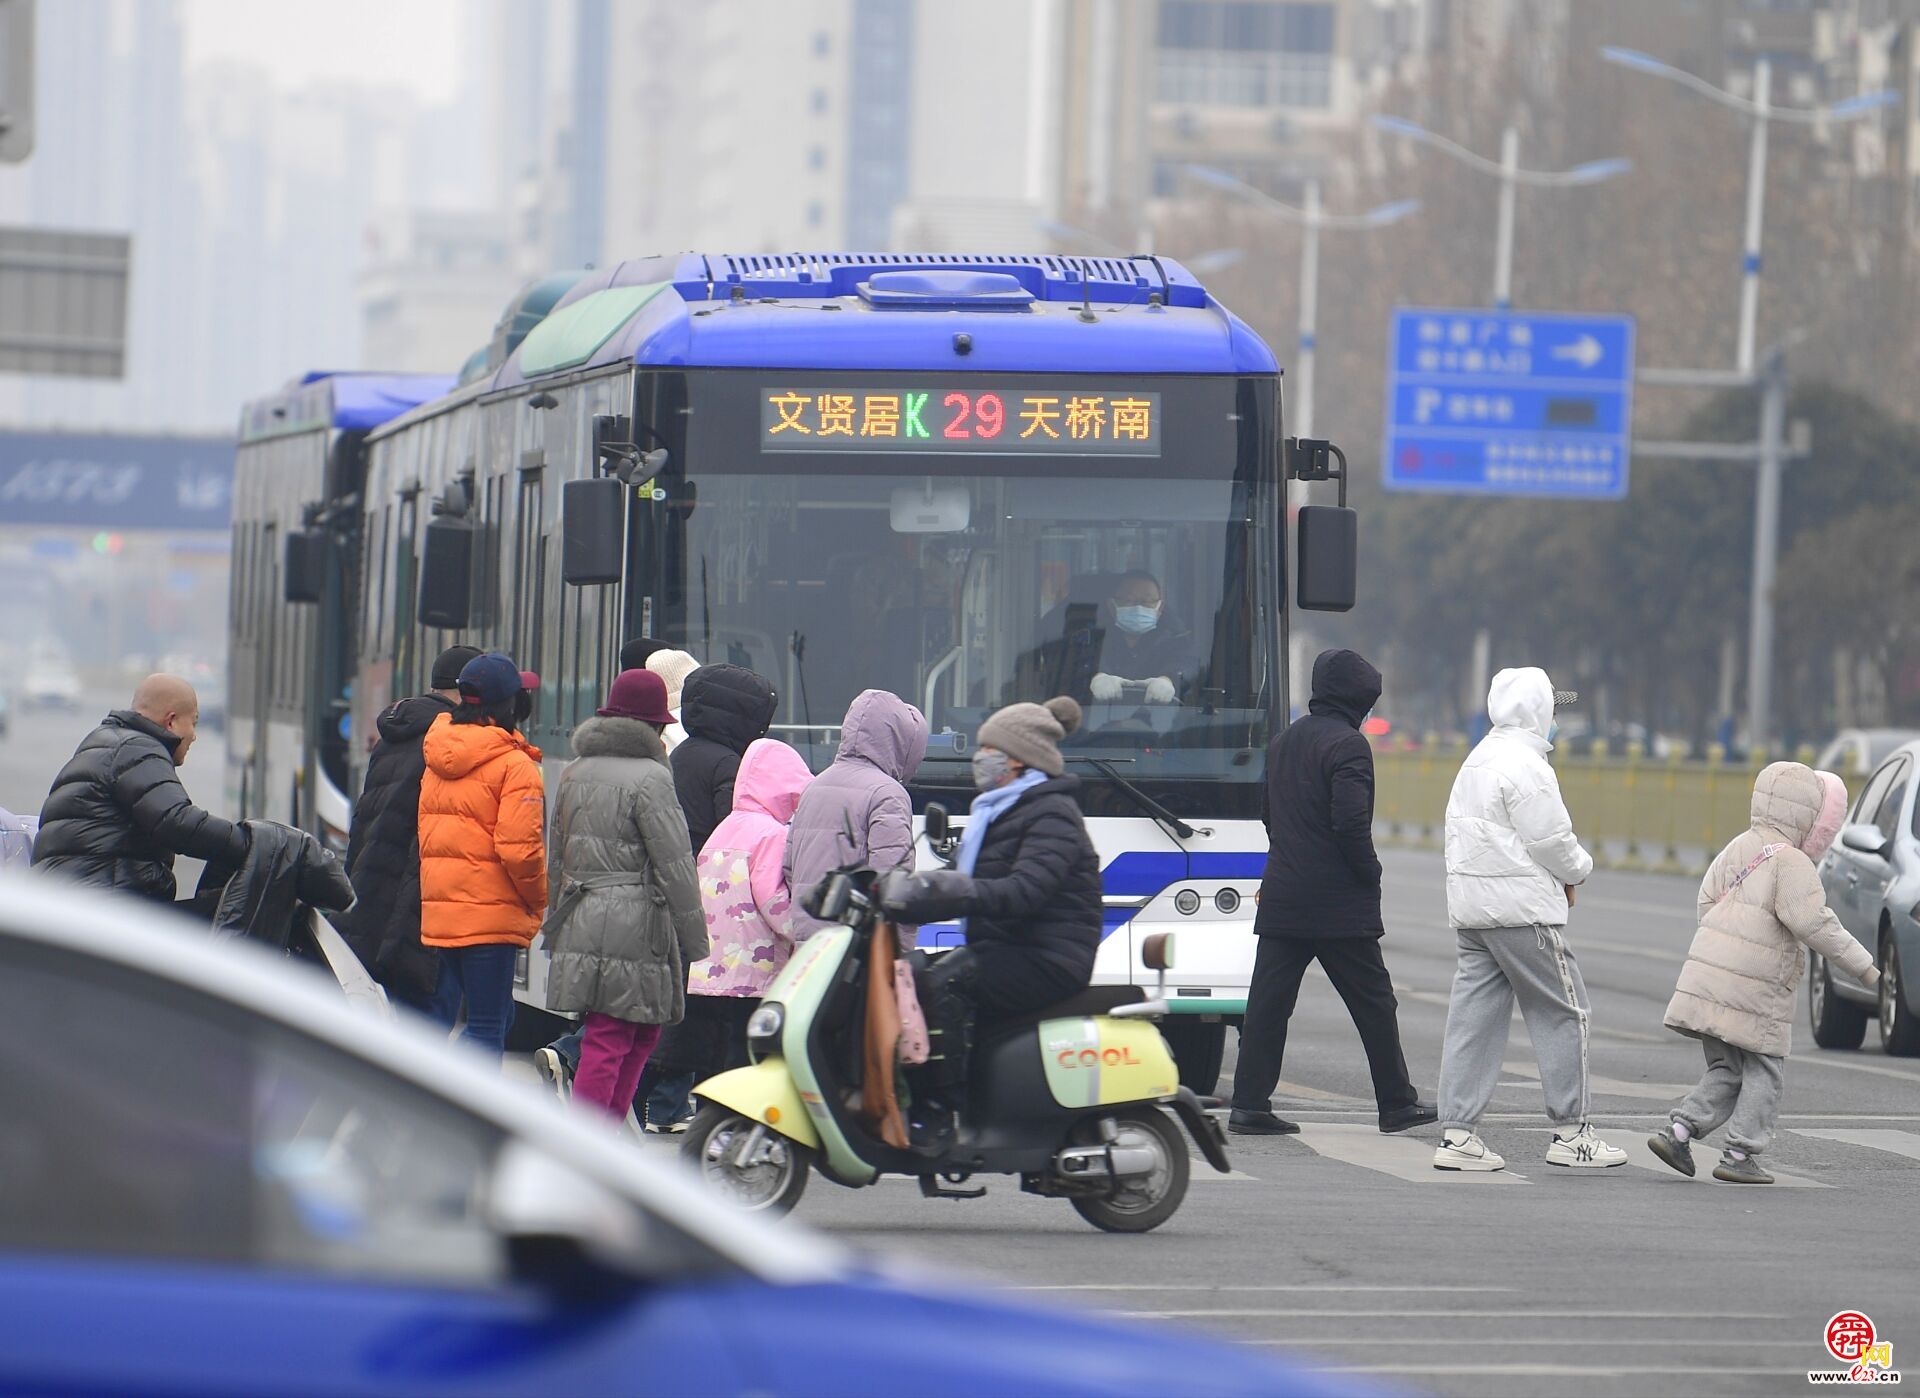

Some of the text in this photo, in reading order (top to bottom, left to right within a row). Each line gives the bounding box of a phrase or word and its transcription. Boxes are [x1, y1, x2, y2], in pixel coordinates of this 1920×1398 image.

[768, 392, 900, 437] 文贤居
[943, 393, 1005, 440] 29
[1019, 396, 1151, 440] 天桥南
[1057, 1047, 1141, 1069] COOL
[1576, 1143, 1593, 1162] NY
